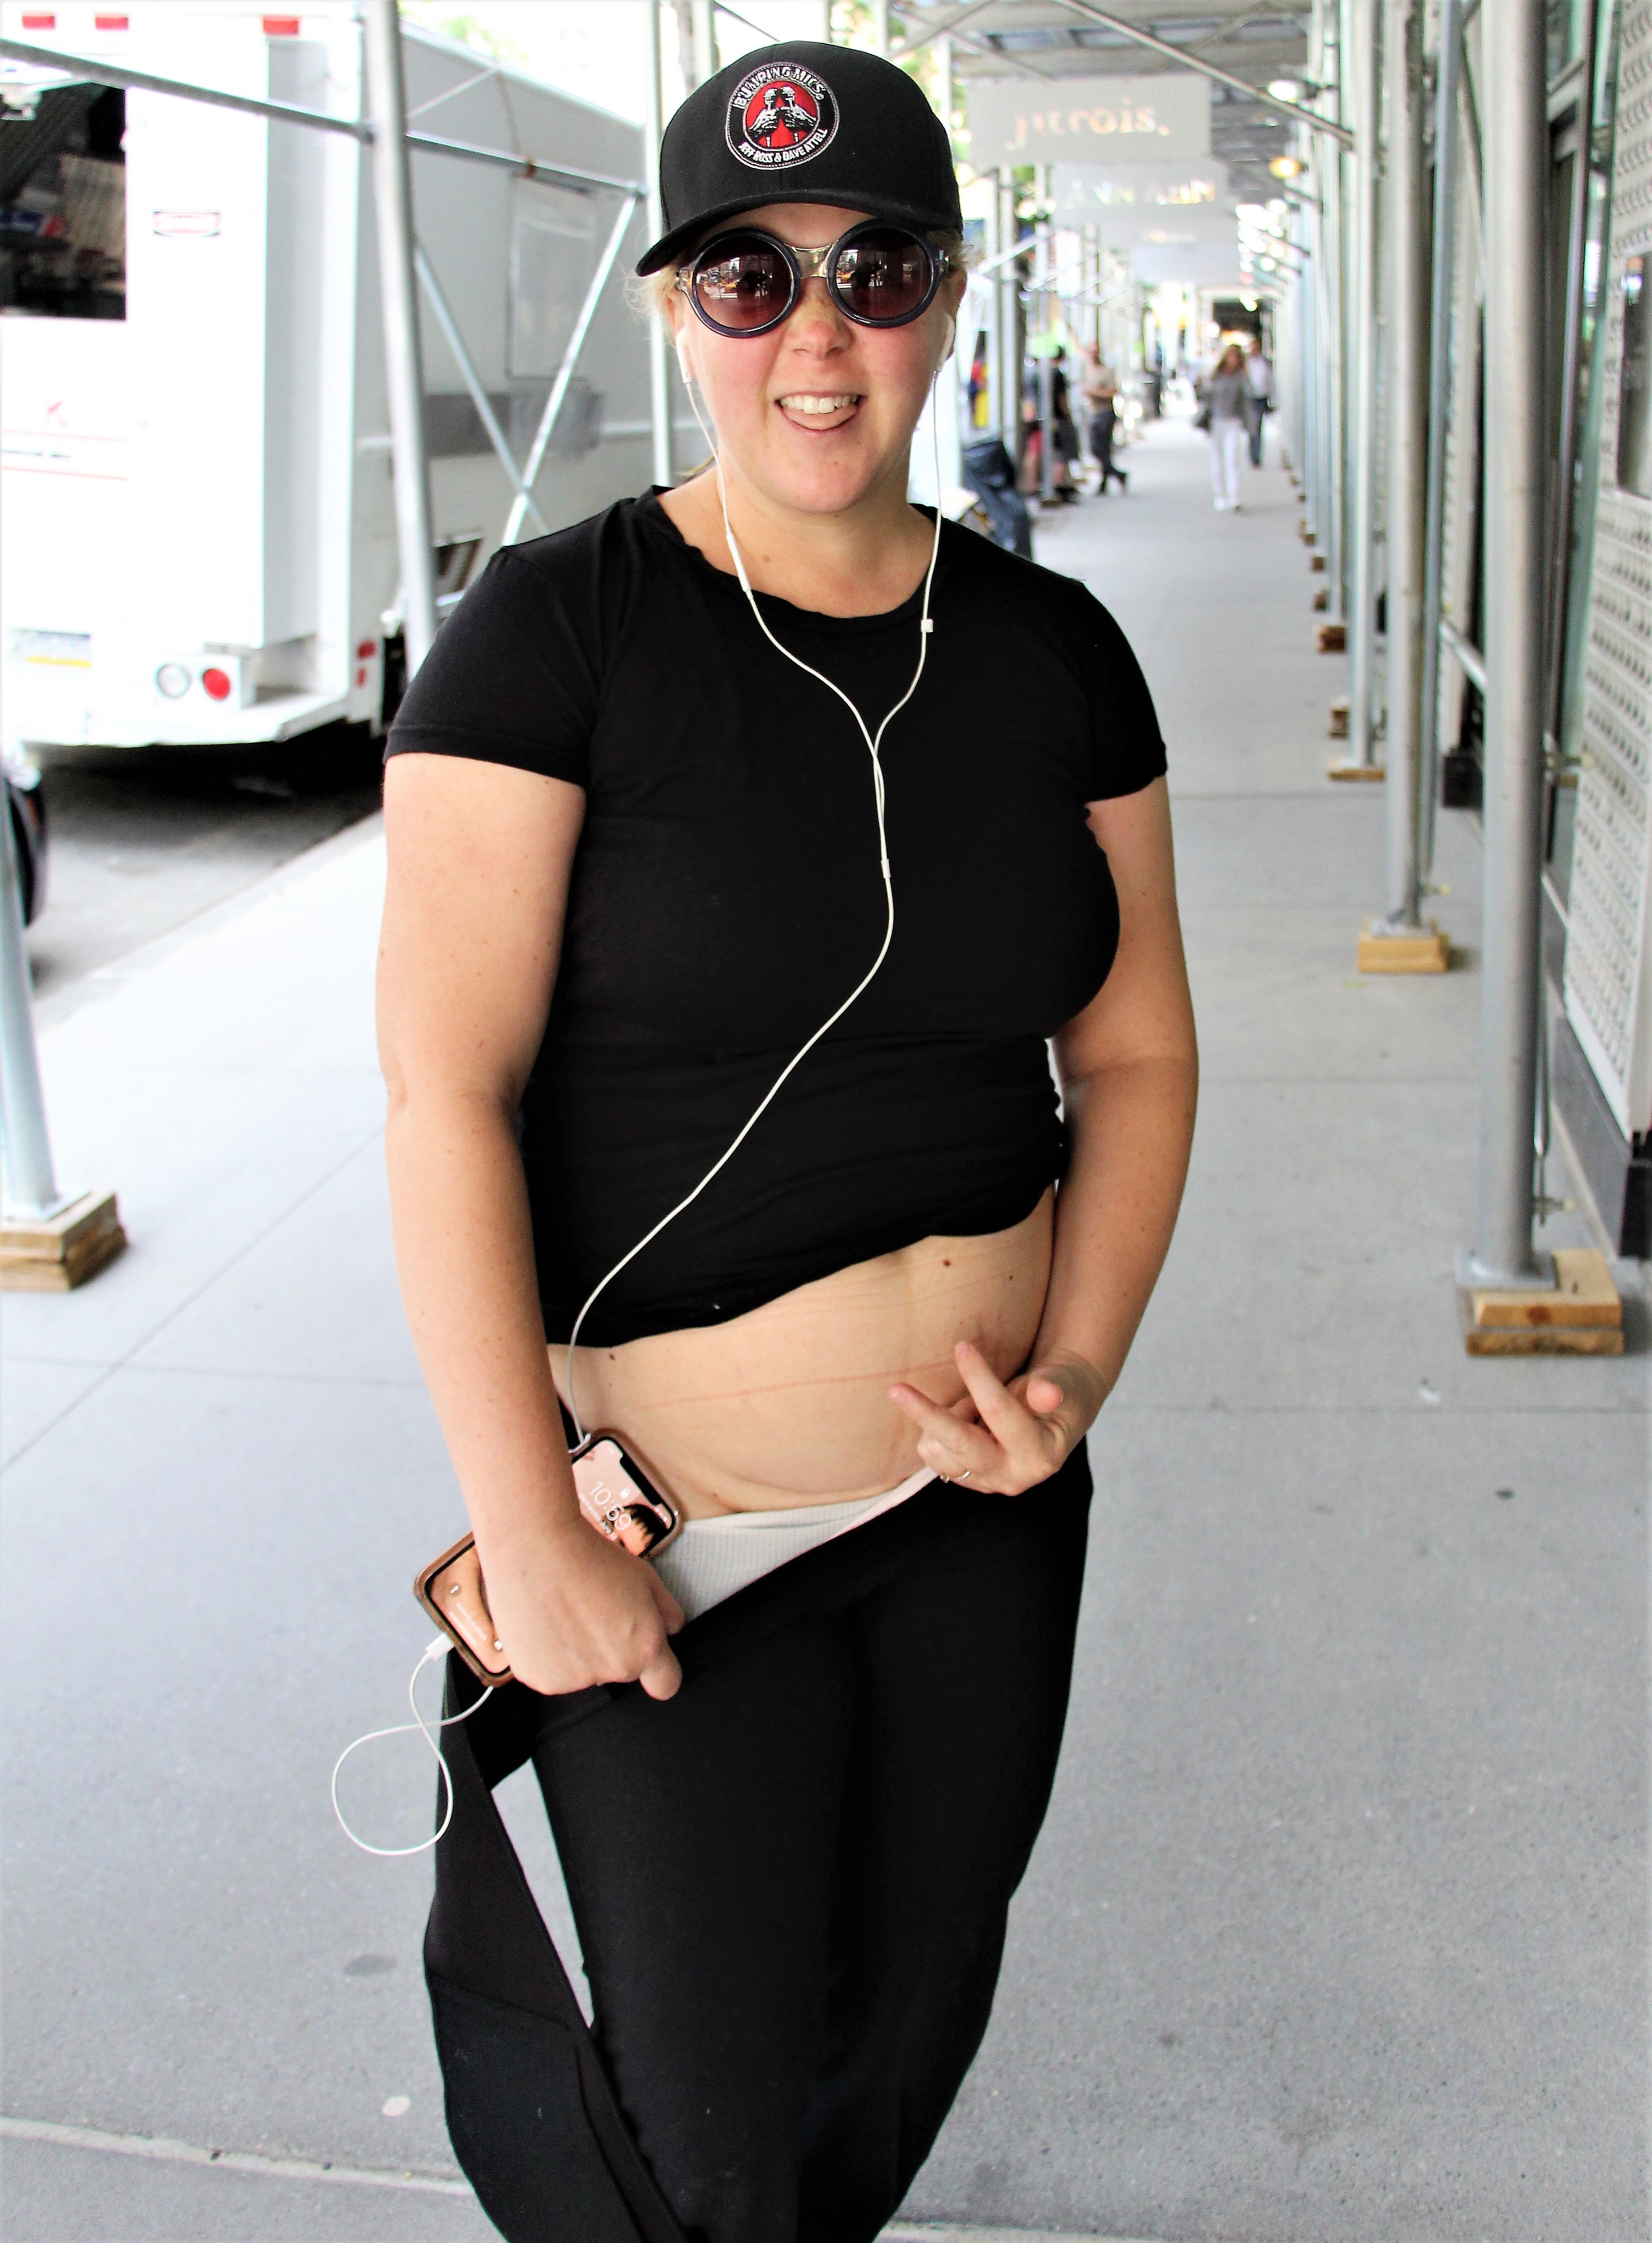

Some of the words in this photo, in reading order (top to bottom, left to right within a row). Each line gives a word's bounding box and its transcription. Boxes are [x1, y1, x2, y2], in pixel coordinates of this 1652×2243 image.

[733, 66, 791, 109] BUMPING
[738, 142, 755, 157] JEFF
[753, 150, 774, 163] ROSS
[774, 152, 782, 162] &
[783, 147, 806, 161] DAVE
[804, 128, 828, 153] ATTELL
[589, 1481, 632, 1531] 10:59
